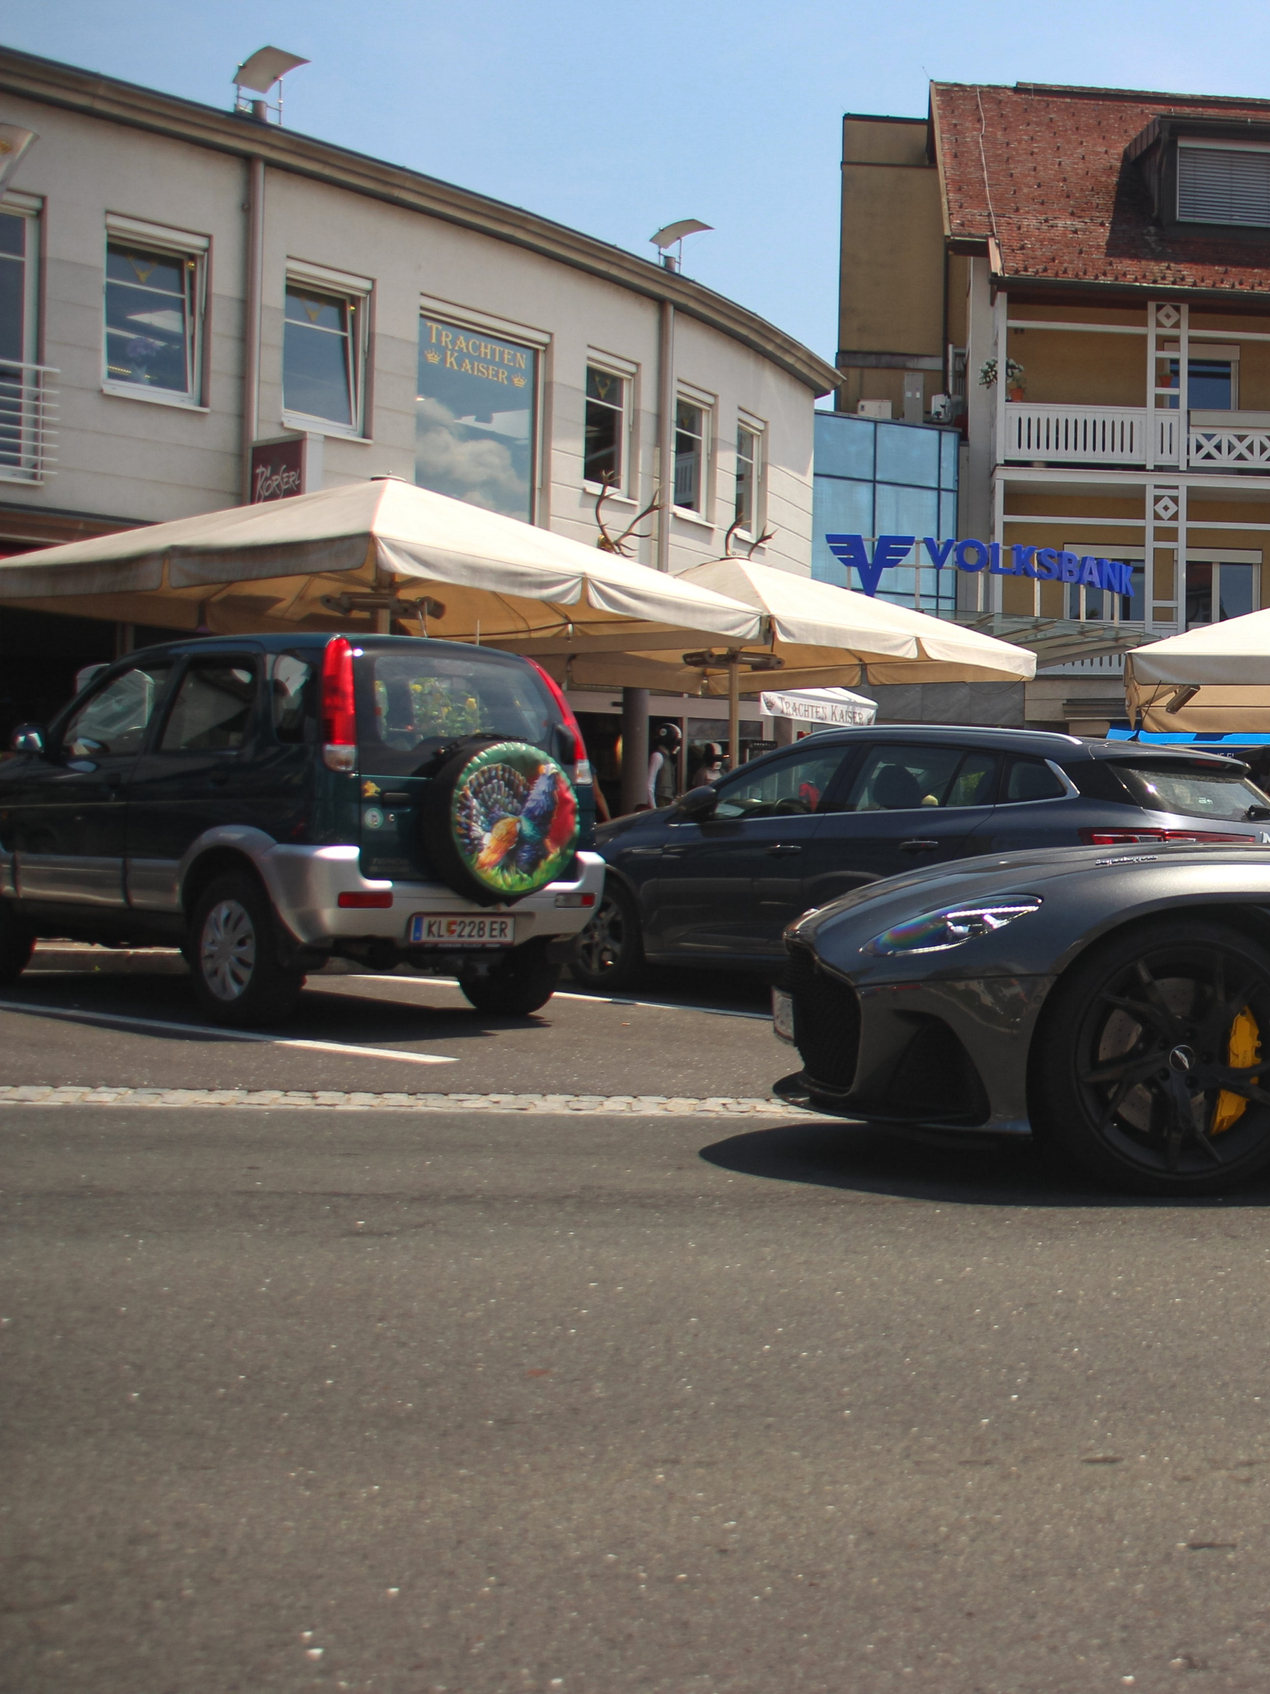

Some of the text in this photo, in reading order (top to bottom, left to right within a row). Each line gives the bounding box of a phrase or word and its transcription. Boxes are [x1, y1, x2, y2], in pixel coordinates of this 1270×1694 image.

[425, 321, 527, 369] TRACHTEN
[445, 350, 508, 385] KAISER
[923, 536, 1135, 597] VOLKSBANK
[777, 696, 864, 726] TRACHTEN KAISER
[427, 919, 509, 938] KL 228 ER
